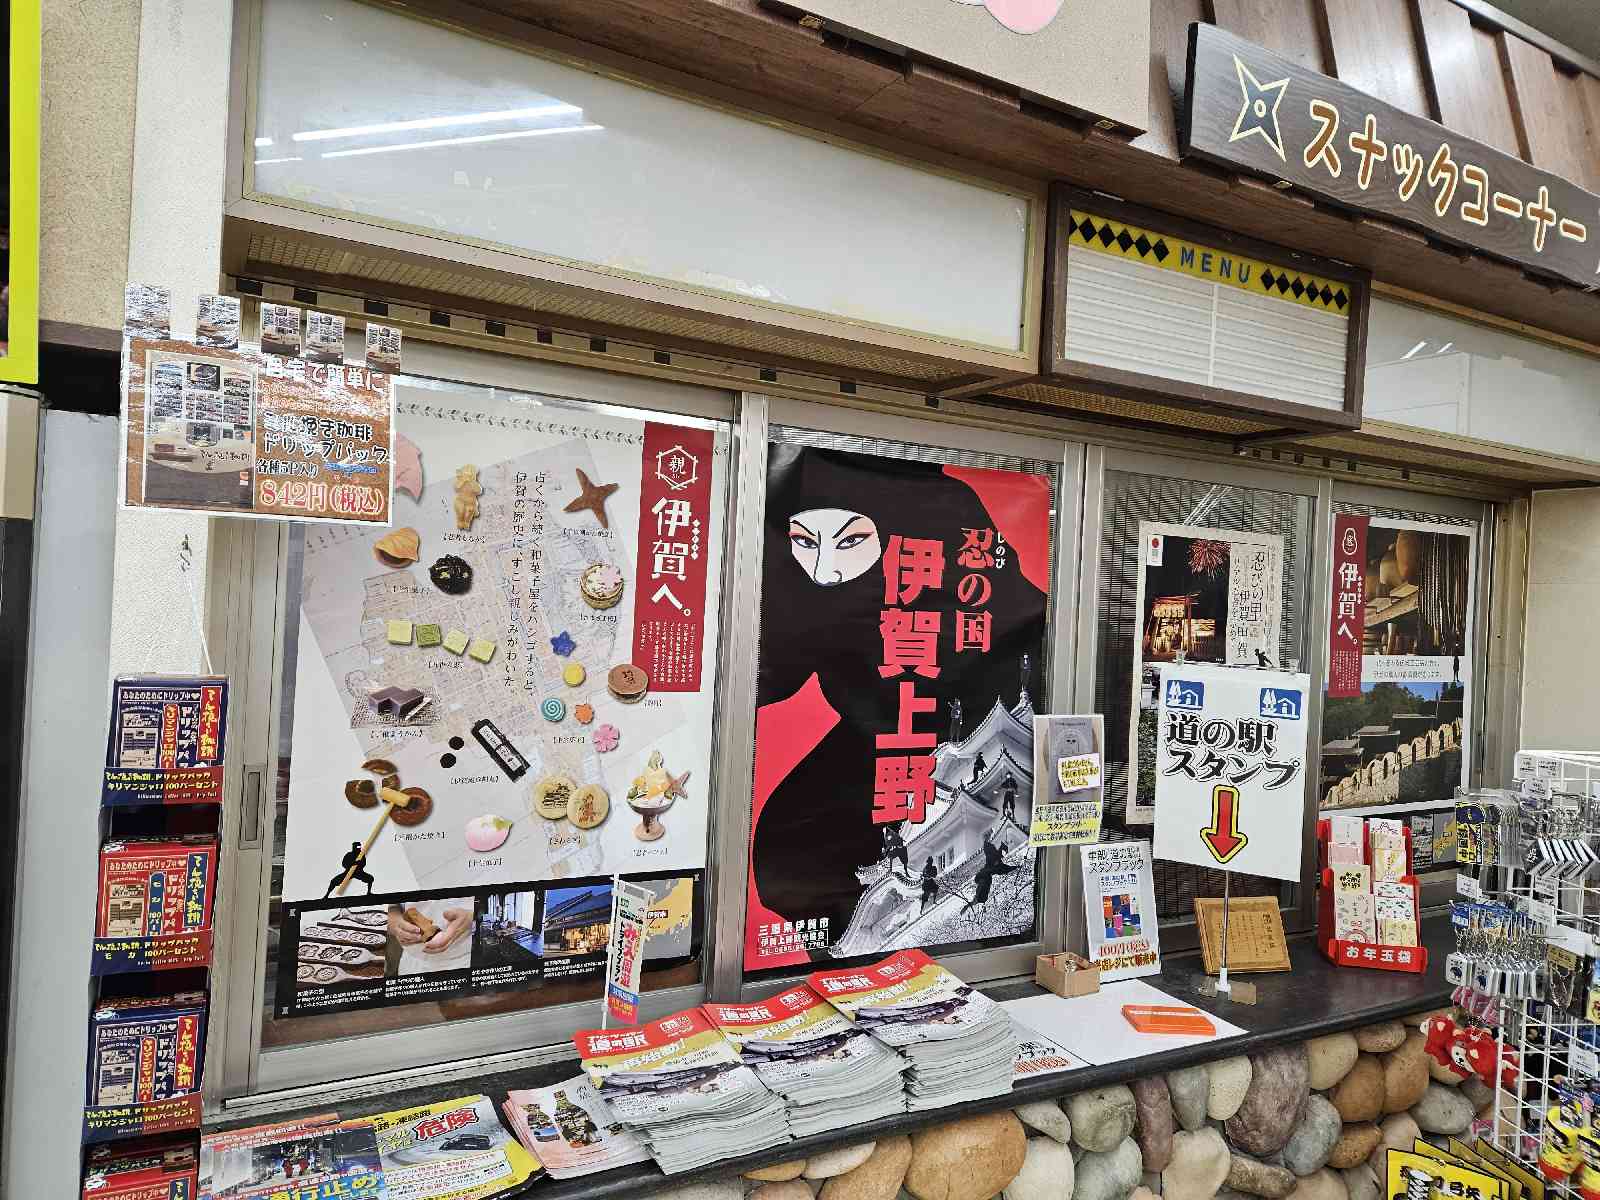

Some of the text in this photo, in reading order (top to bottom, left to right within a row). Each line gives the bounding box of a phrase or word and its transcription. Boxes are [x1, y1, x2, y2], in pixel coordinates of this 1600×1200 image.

[1304, 99, 1587, 252] スナックコーナー
[1180, 246, 1251, 283] MENU
[650, 496, 692, 617] 伊賀へ。
[996, 531, 1006, 569] しのび
[955, 527, 993, 653] 忍の国
[1337, 561, 1359, 645] 伊賀へ。
[872, 534, 945, 825] 伊賀上野
[1165, 712, 1277, 757] 道の駅
[1163, 747, 1301, 790] スタンプ
[1346, 945, 1412, 964] お年玉袋
[588, 1034, 648, 1052] 道の駅
[417, 1108, 477, 1141] 危険
